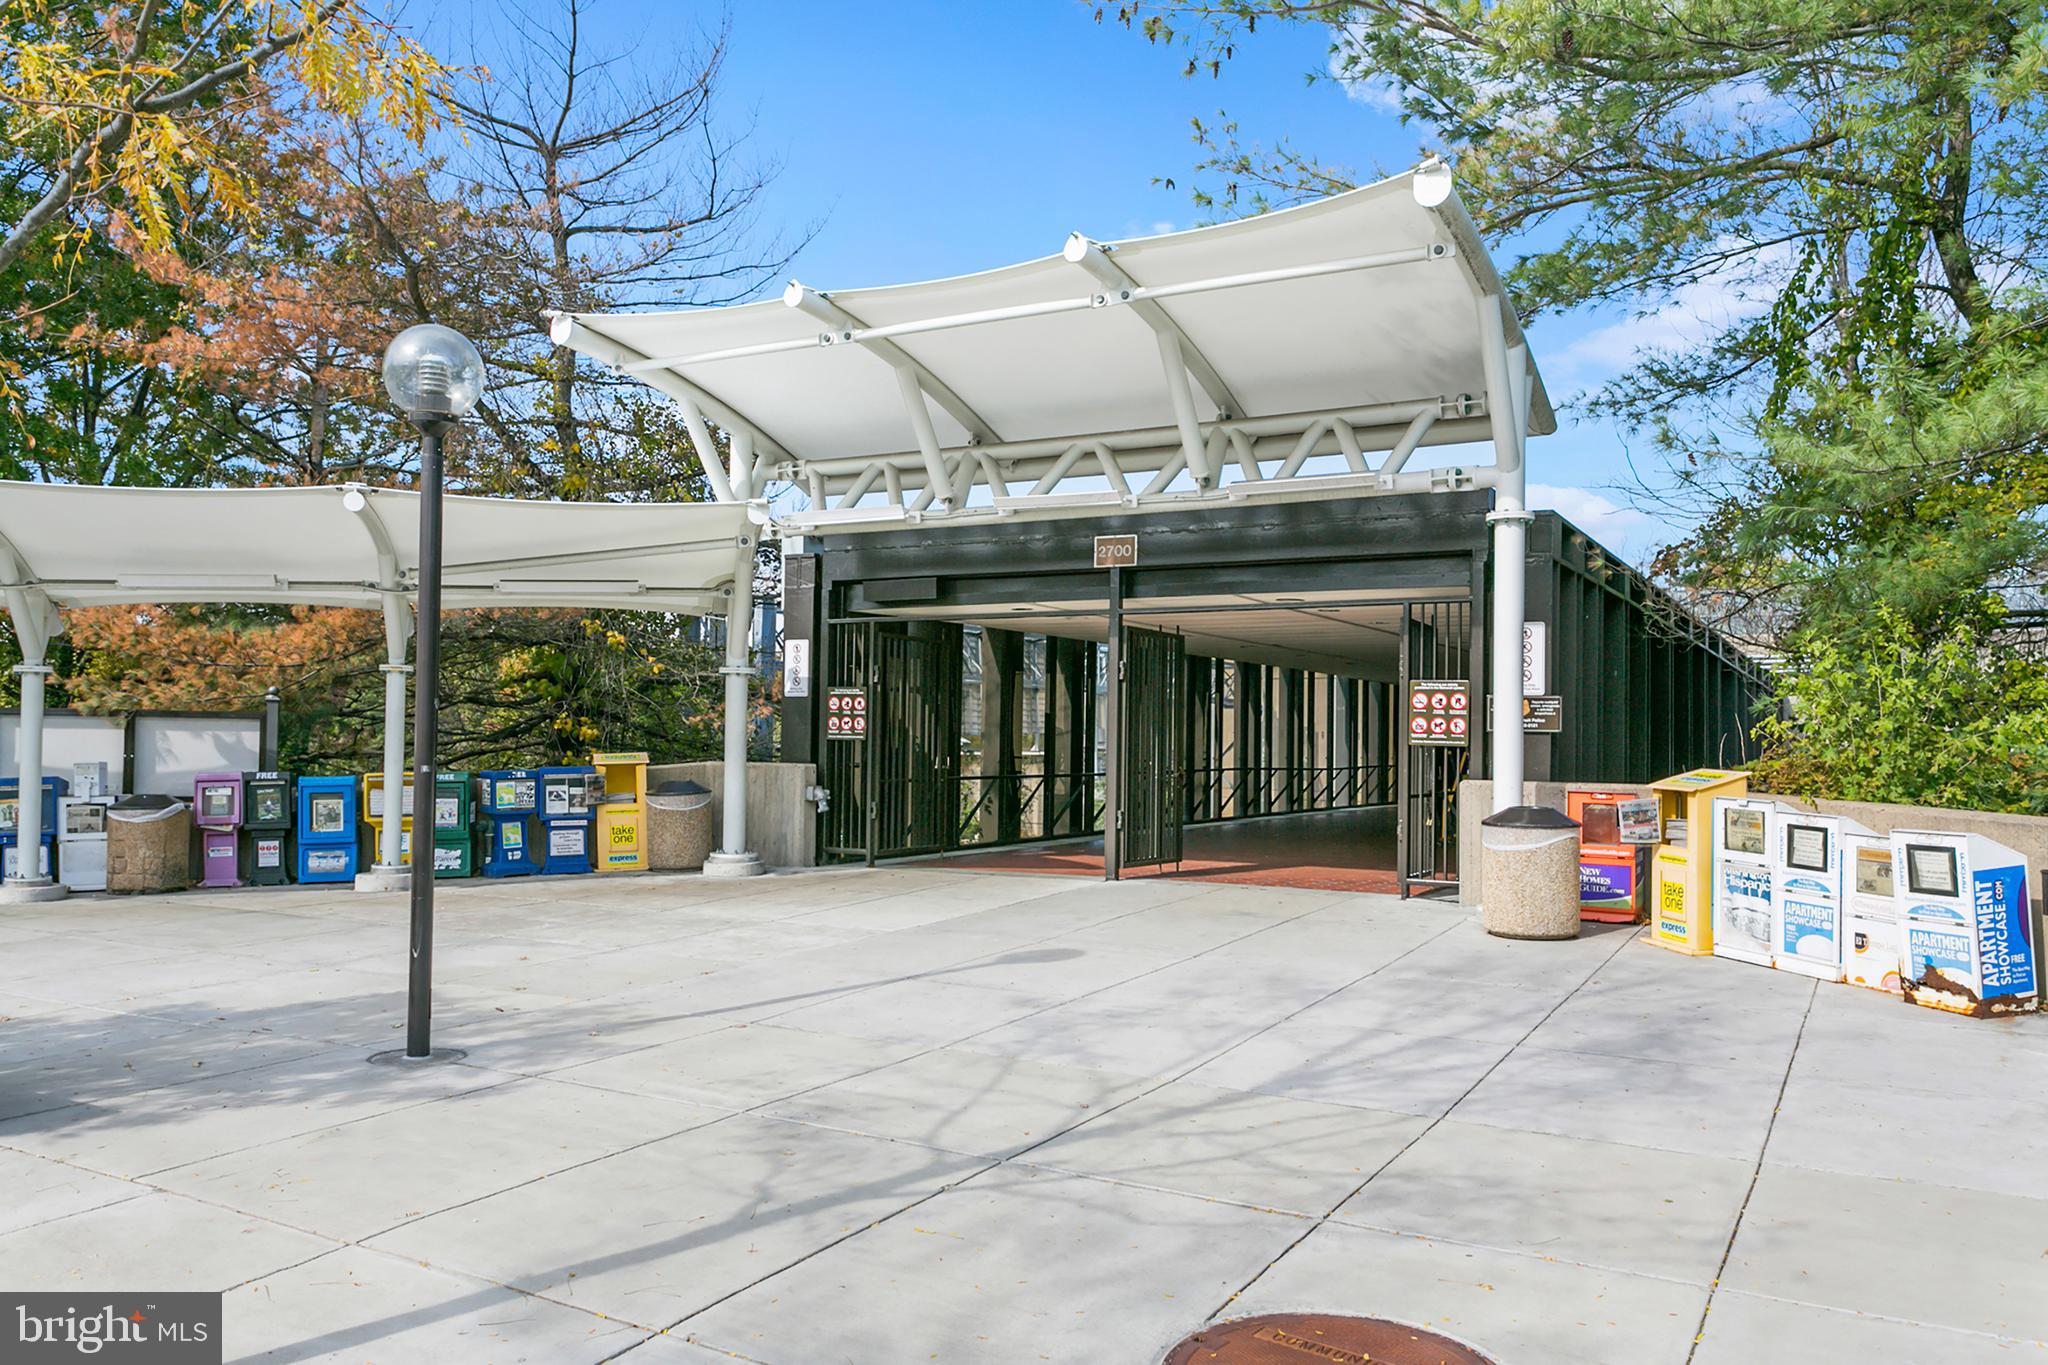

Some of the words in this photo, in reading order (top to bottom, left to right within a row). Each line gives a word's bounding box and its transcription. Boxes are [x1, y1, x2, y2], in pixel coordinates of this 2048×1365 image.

[1098, 544, 1132, 558] 2700
[255, 771, 278, 779] FREE
[611, 824, 635, 835] take
[613, 834, 633, 844] one
[608, 854, 638, 863] express
[1580, 866, 1602, 876] NEW
[1580, 875, 1611, 885] HOMES
[1664, 882, 1685, 898] take
[1664, 896, 1684, 911] one
[1785, 901, 1833, 921] APARTMENT
[1660, 921, 1687, 934] express
[1784, 914, 1823, 928] SHOWCASE
[1975, 880, 2001, 987] APARTMENT
[1911, 931, 1970, 952] APARTMENT
[1911, 945, 1956, 960] SHOWCASE
[2011, 953, 2026, 964] FREE
